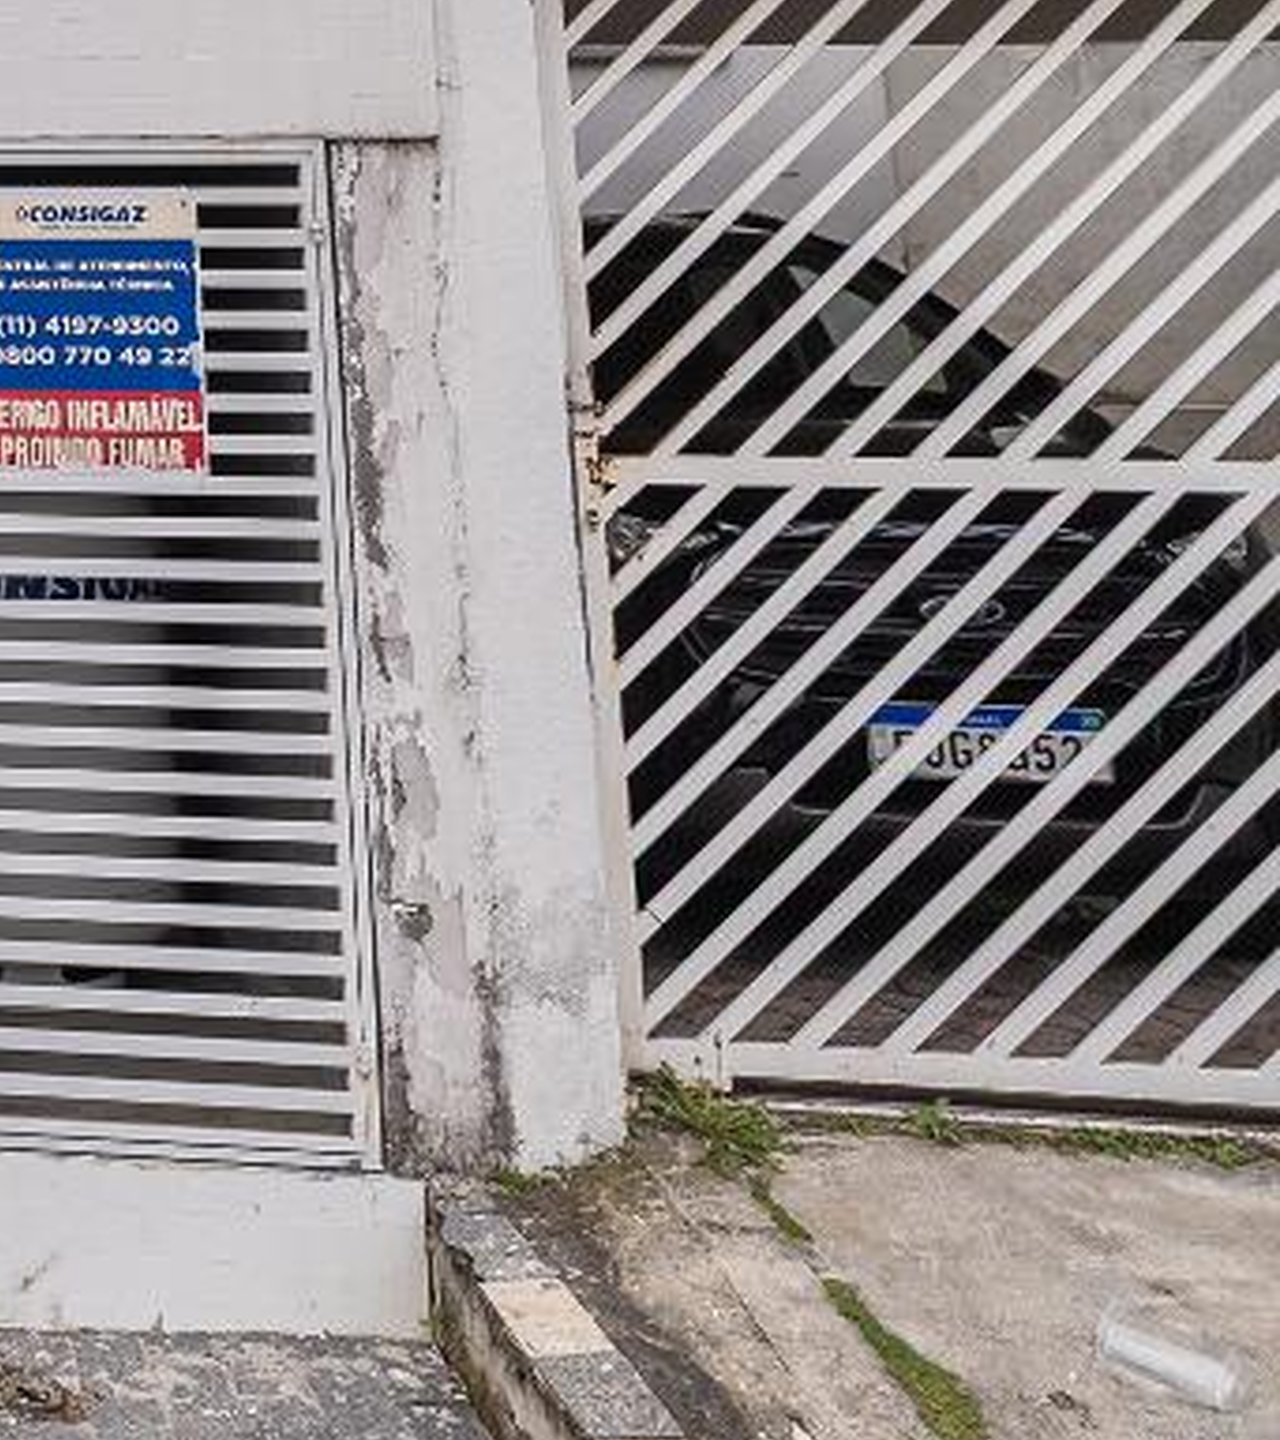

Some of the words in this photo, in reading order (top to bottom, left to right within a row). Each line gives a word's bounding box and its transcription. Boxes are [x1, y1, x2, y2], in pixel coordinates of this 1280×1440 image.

[29, 205, 147, 222] CONSIGAZ
[63, 347, 111, 365] 770
[158, 348, 191, 366] 22
[108, 435, 186, 467] FUMAR
